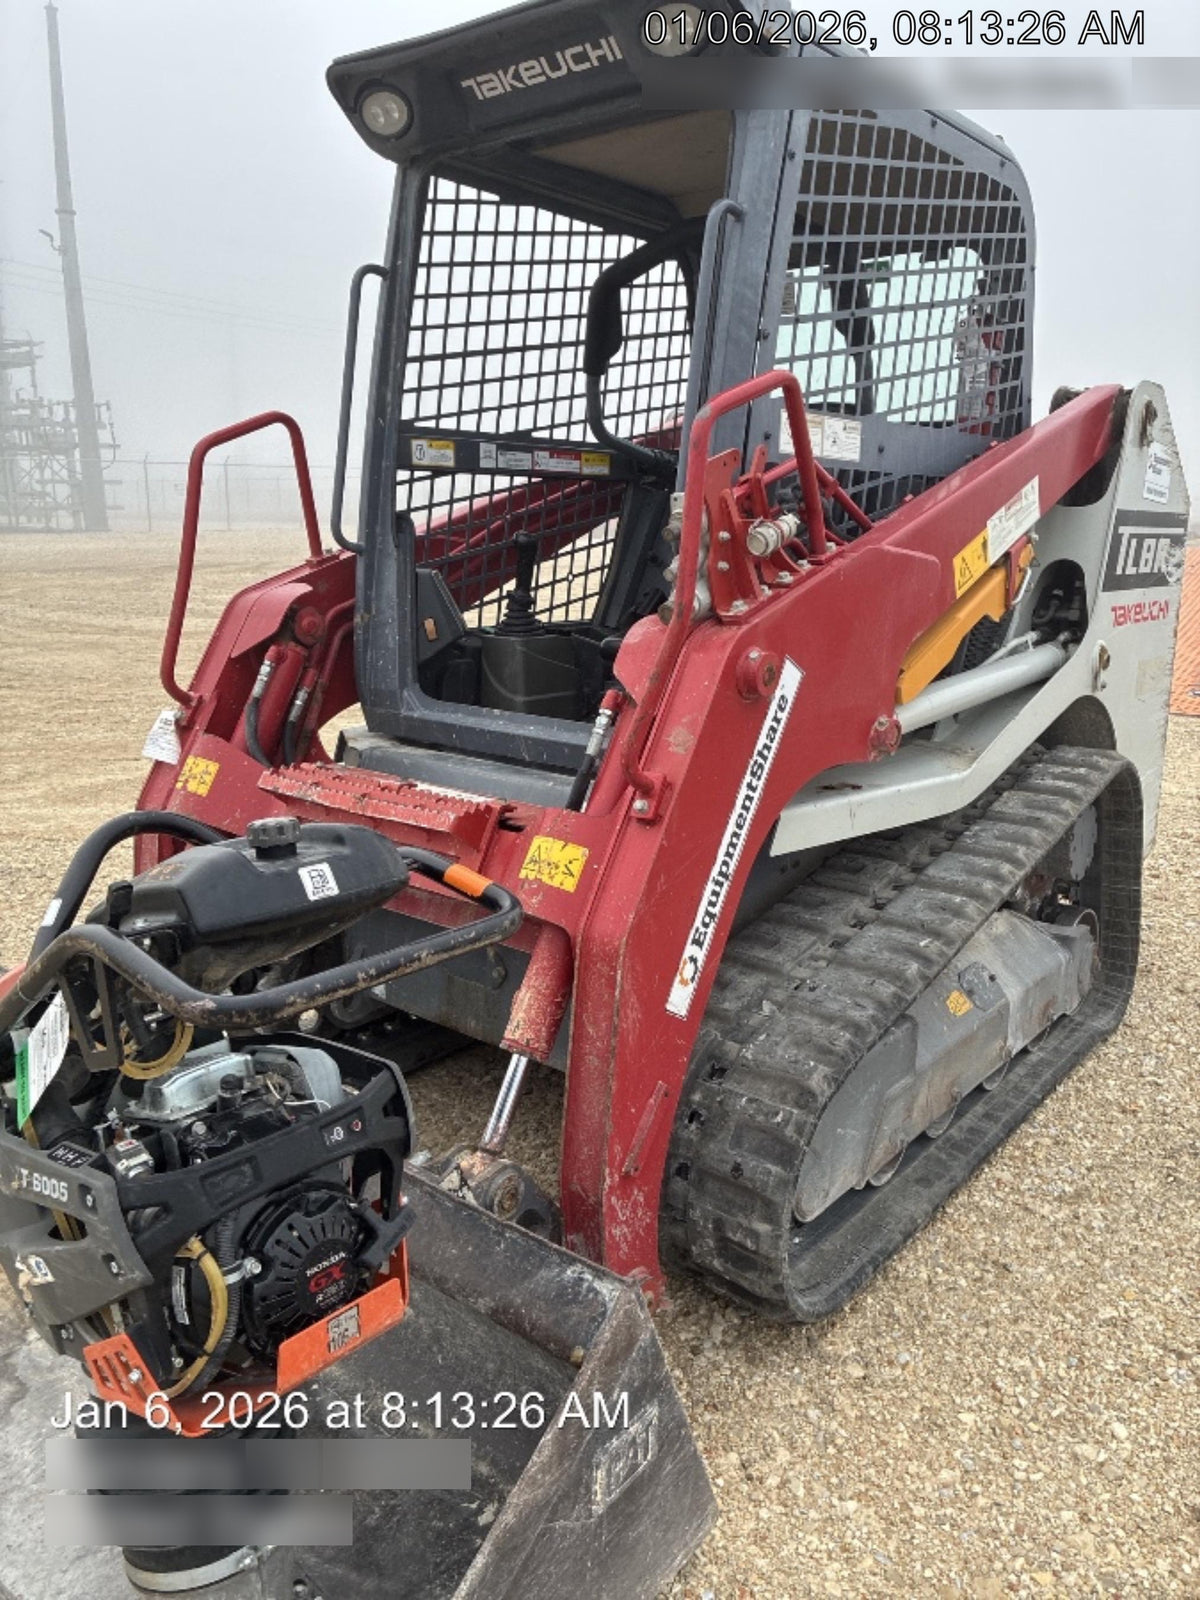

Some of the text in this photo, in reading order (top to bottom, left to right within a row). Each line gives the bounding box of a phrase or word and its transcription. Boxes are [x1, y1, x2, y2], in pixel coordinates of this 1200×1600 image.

[690, 693, 789, 951] EquipmentShare
[32, 1172, 69, 1203] 6005
[305, 1251, 347, 1278] HONDA
[308, 1261, 347, 1294] GX
